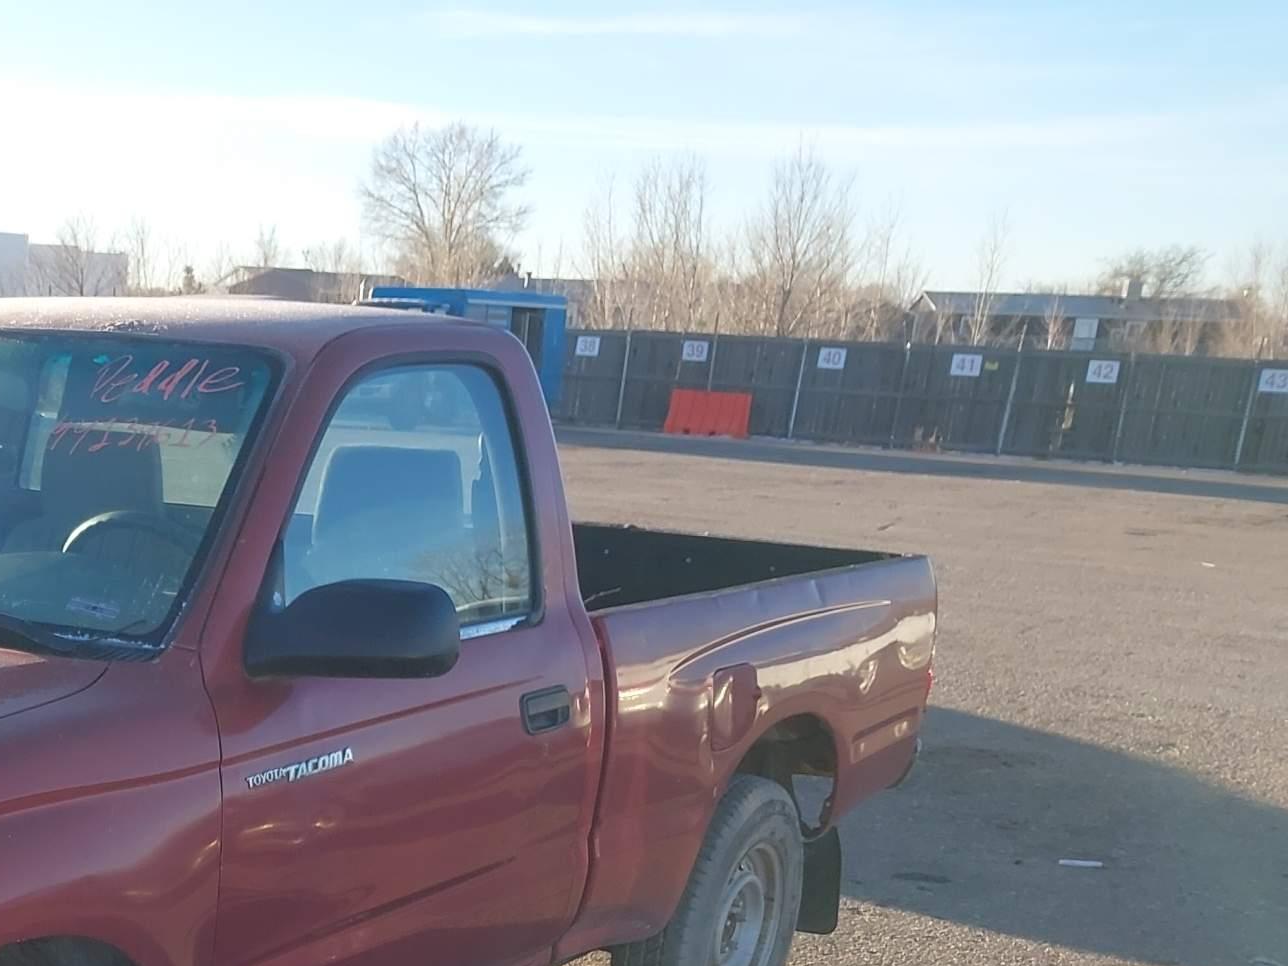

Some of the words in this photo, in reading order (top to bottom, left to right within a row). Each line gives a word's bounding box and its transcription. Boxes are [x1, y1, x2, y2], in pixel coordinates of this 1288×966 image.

[580, 339, 596, 352] 38
[687, 344, 704, 358] 39
[822, 352, 841, 365] 40
[955, 357, 976, 371] 41
[1092, 363, 1114, 379] 42
[1265, 373, 1288, 389] 43
[246, 769, 286, 788] TOYOTA
[286, 747, 354, 781] TACOMA
